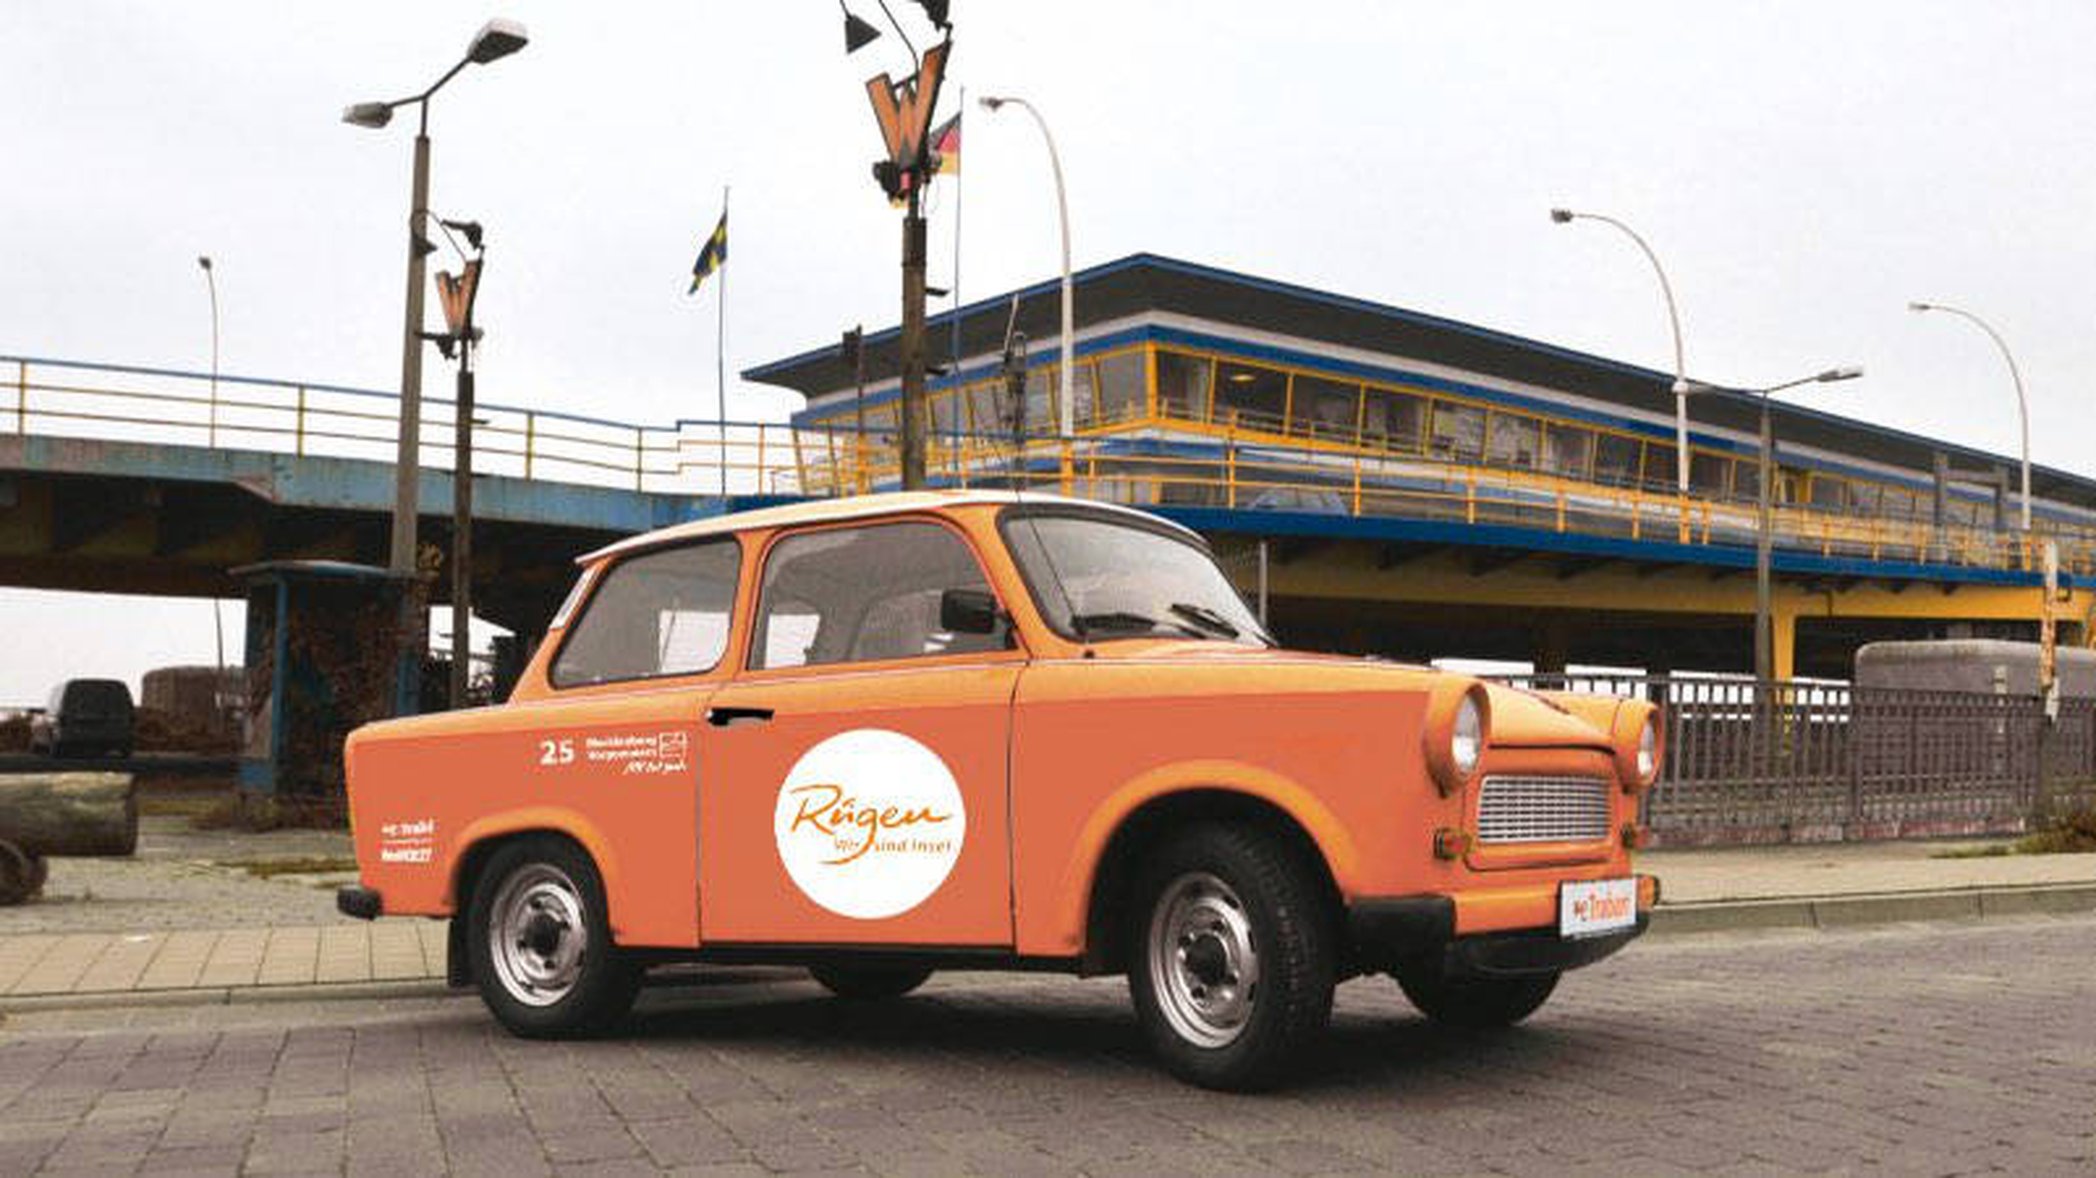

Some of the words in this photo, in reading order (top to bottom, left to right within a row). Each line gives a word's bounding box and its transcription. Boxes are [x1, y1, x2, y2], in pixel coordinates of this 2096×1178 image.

[539, 740, 574, 765] 25
[788, 783, 954, 866] Rügen
[912, 839, 951, 853] Insel
